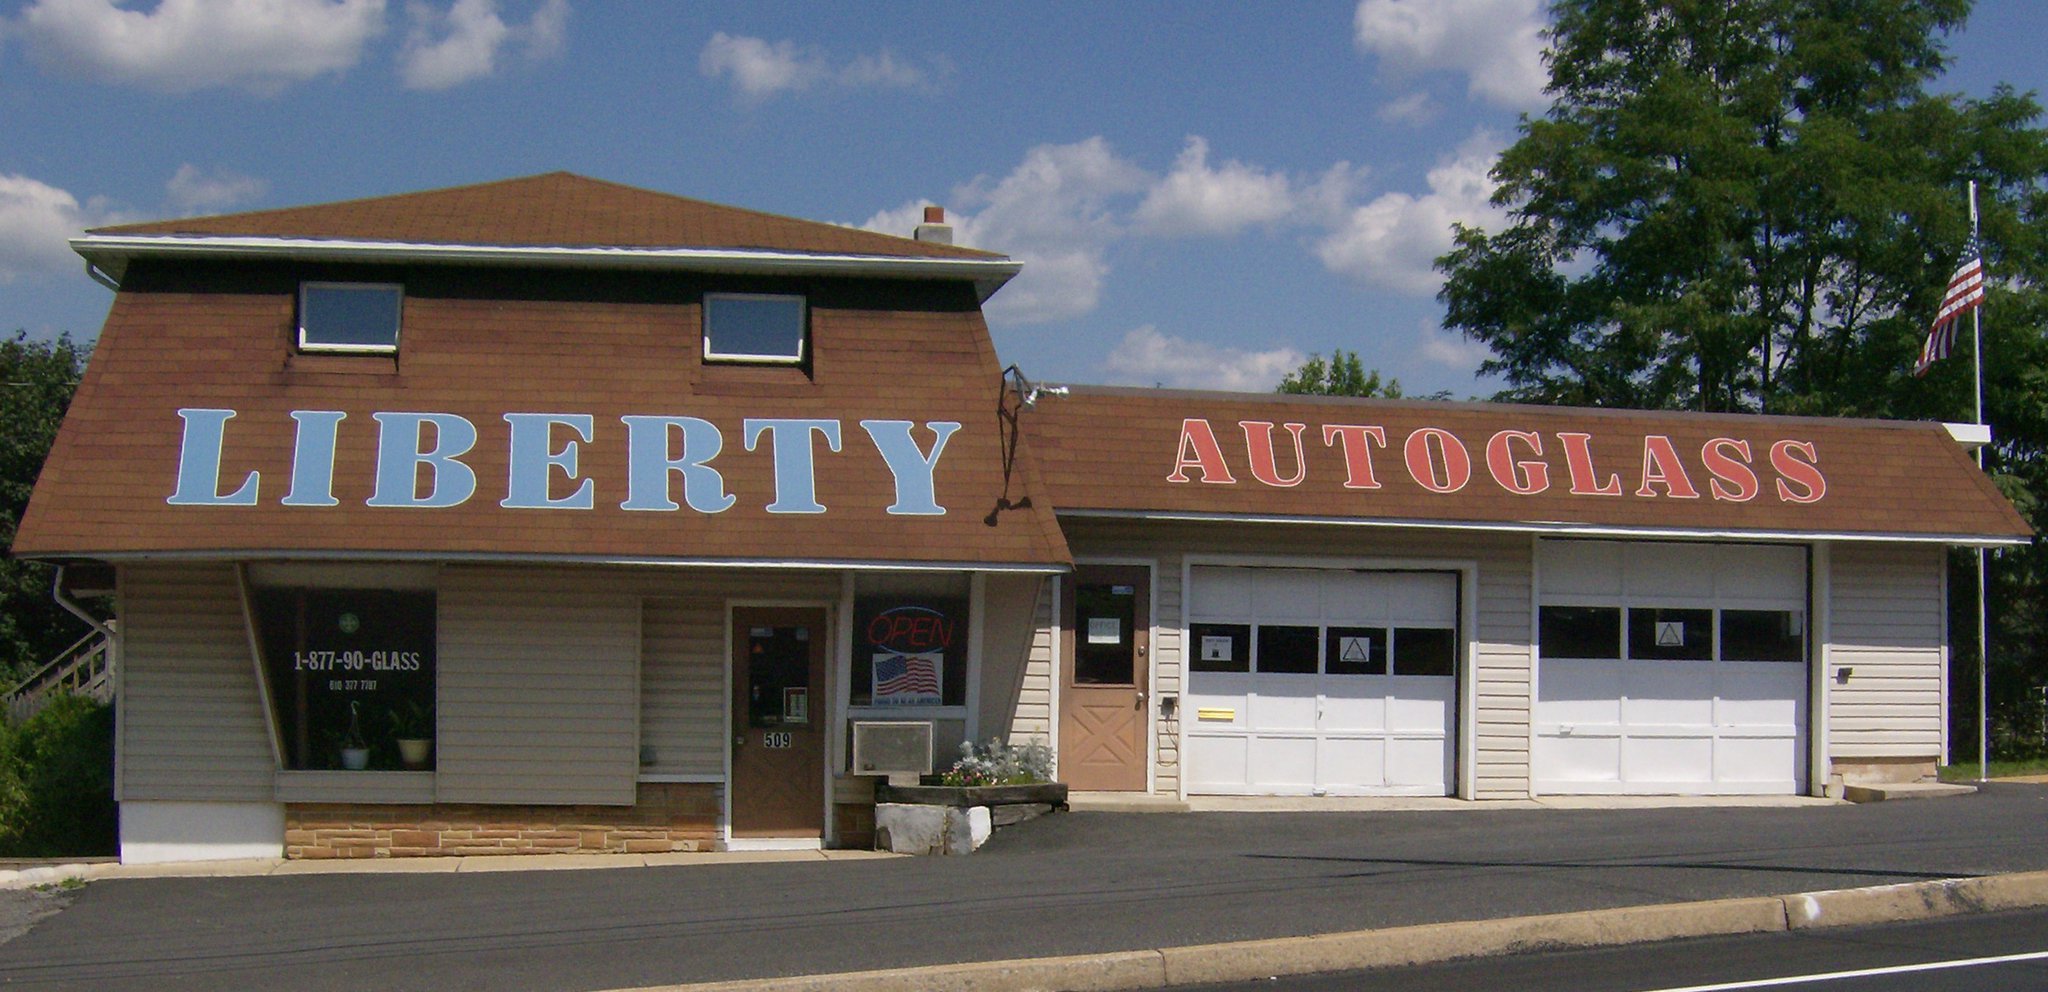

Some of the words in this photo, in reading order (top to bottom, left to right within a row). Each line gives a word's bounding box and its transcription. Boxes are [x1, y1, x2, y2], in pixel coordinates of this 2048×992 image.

[166, 408, 962, 515] LIBERTY
[1166, 418, 1827, 503] AUTOGLASS
[868, 615, 954, 647] OPEN
[294, 651, 420, 670] 1-877-90-GLASS
[765, 733, 791, 748] 509
